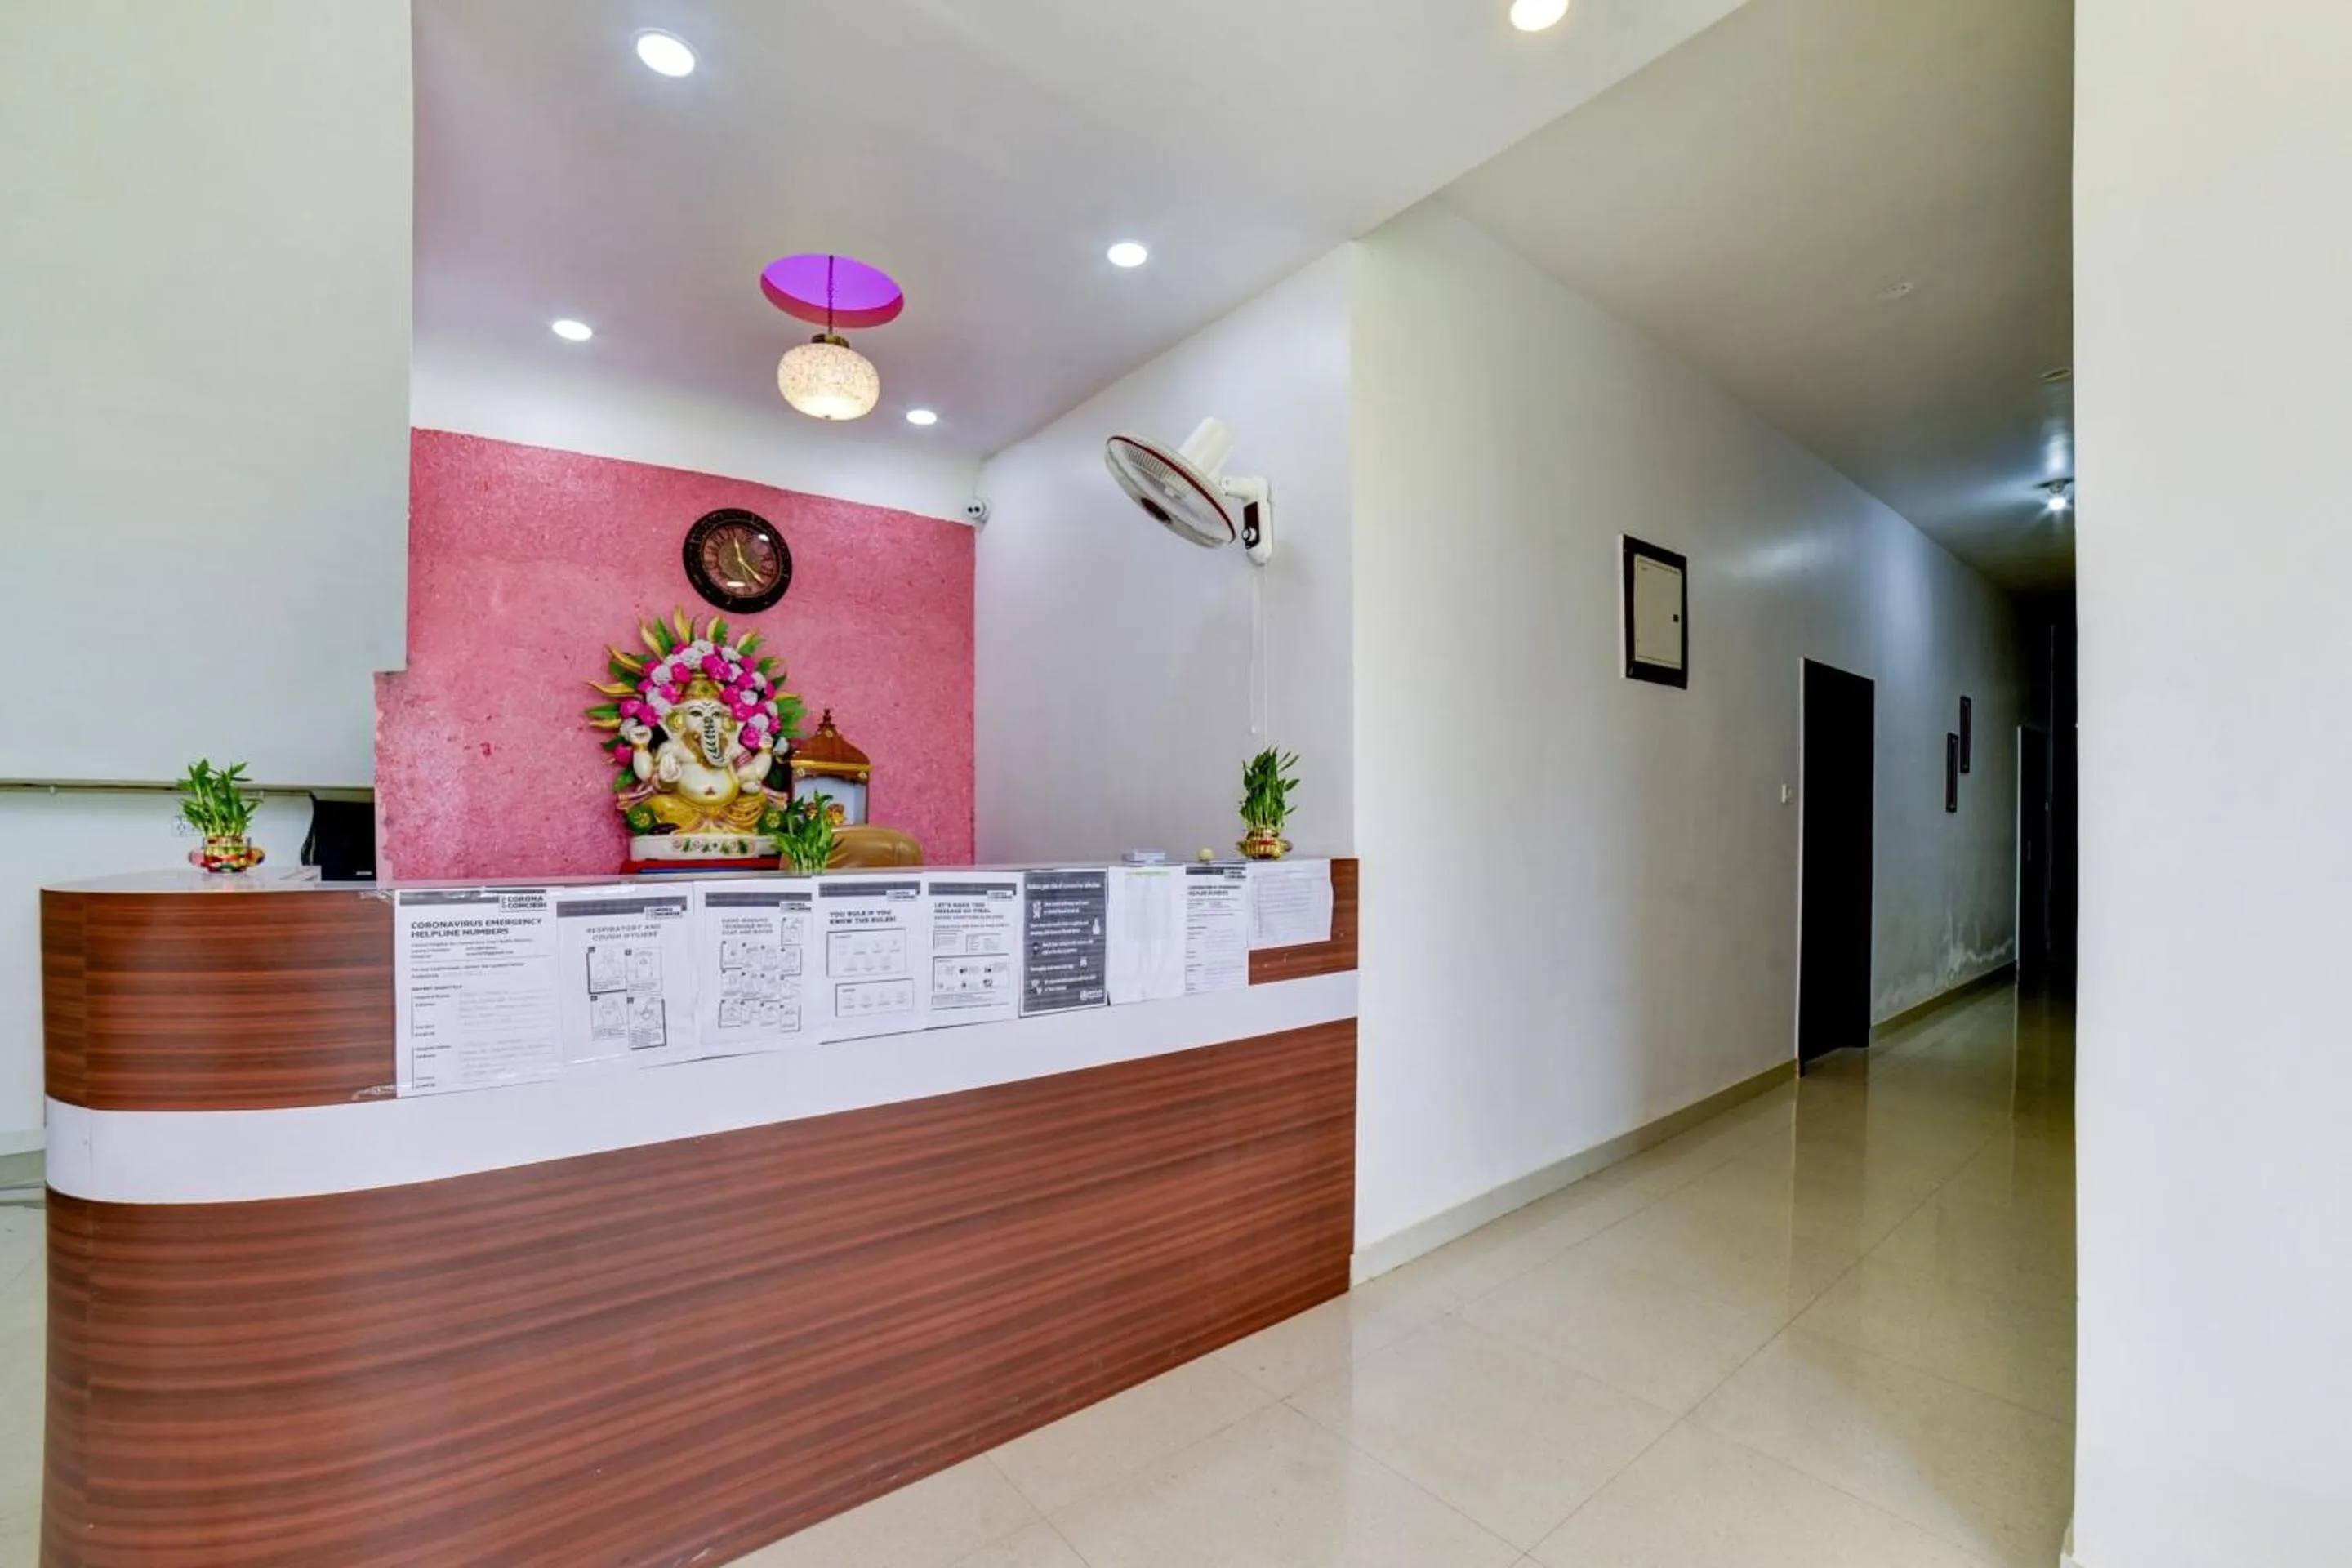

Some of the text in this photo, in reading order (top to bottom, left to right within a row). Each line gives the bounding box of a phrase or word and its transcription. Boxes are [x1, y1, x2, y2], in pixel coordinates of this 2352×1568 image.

[411, 917, 542, 929] CORONAVIRUS EMERGENCY
[411, 928, 510, 938] HELPLINE NUMBERS
[586, 924, 642, 933] RESPIRATORY
[592, 930, 658, 941] COUGH HYGIENE
